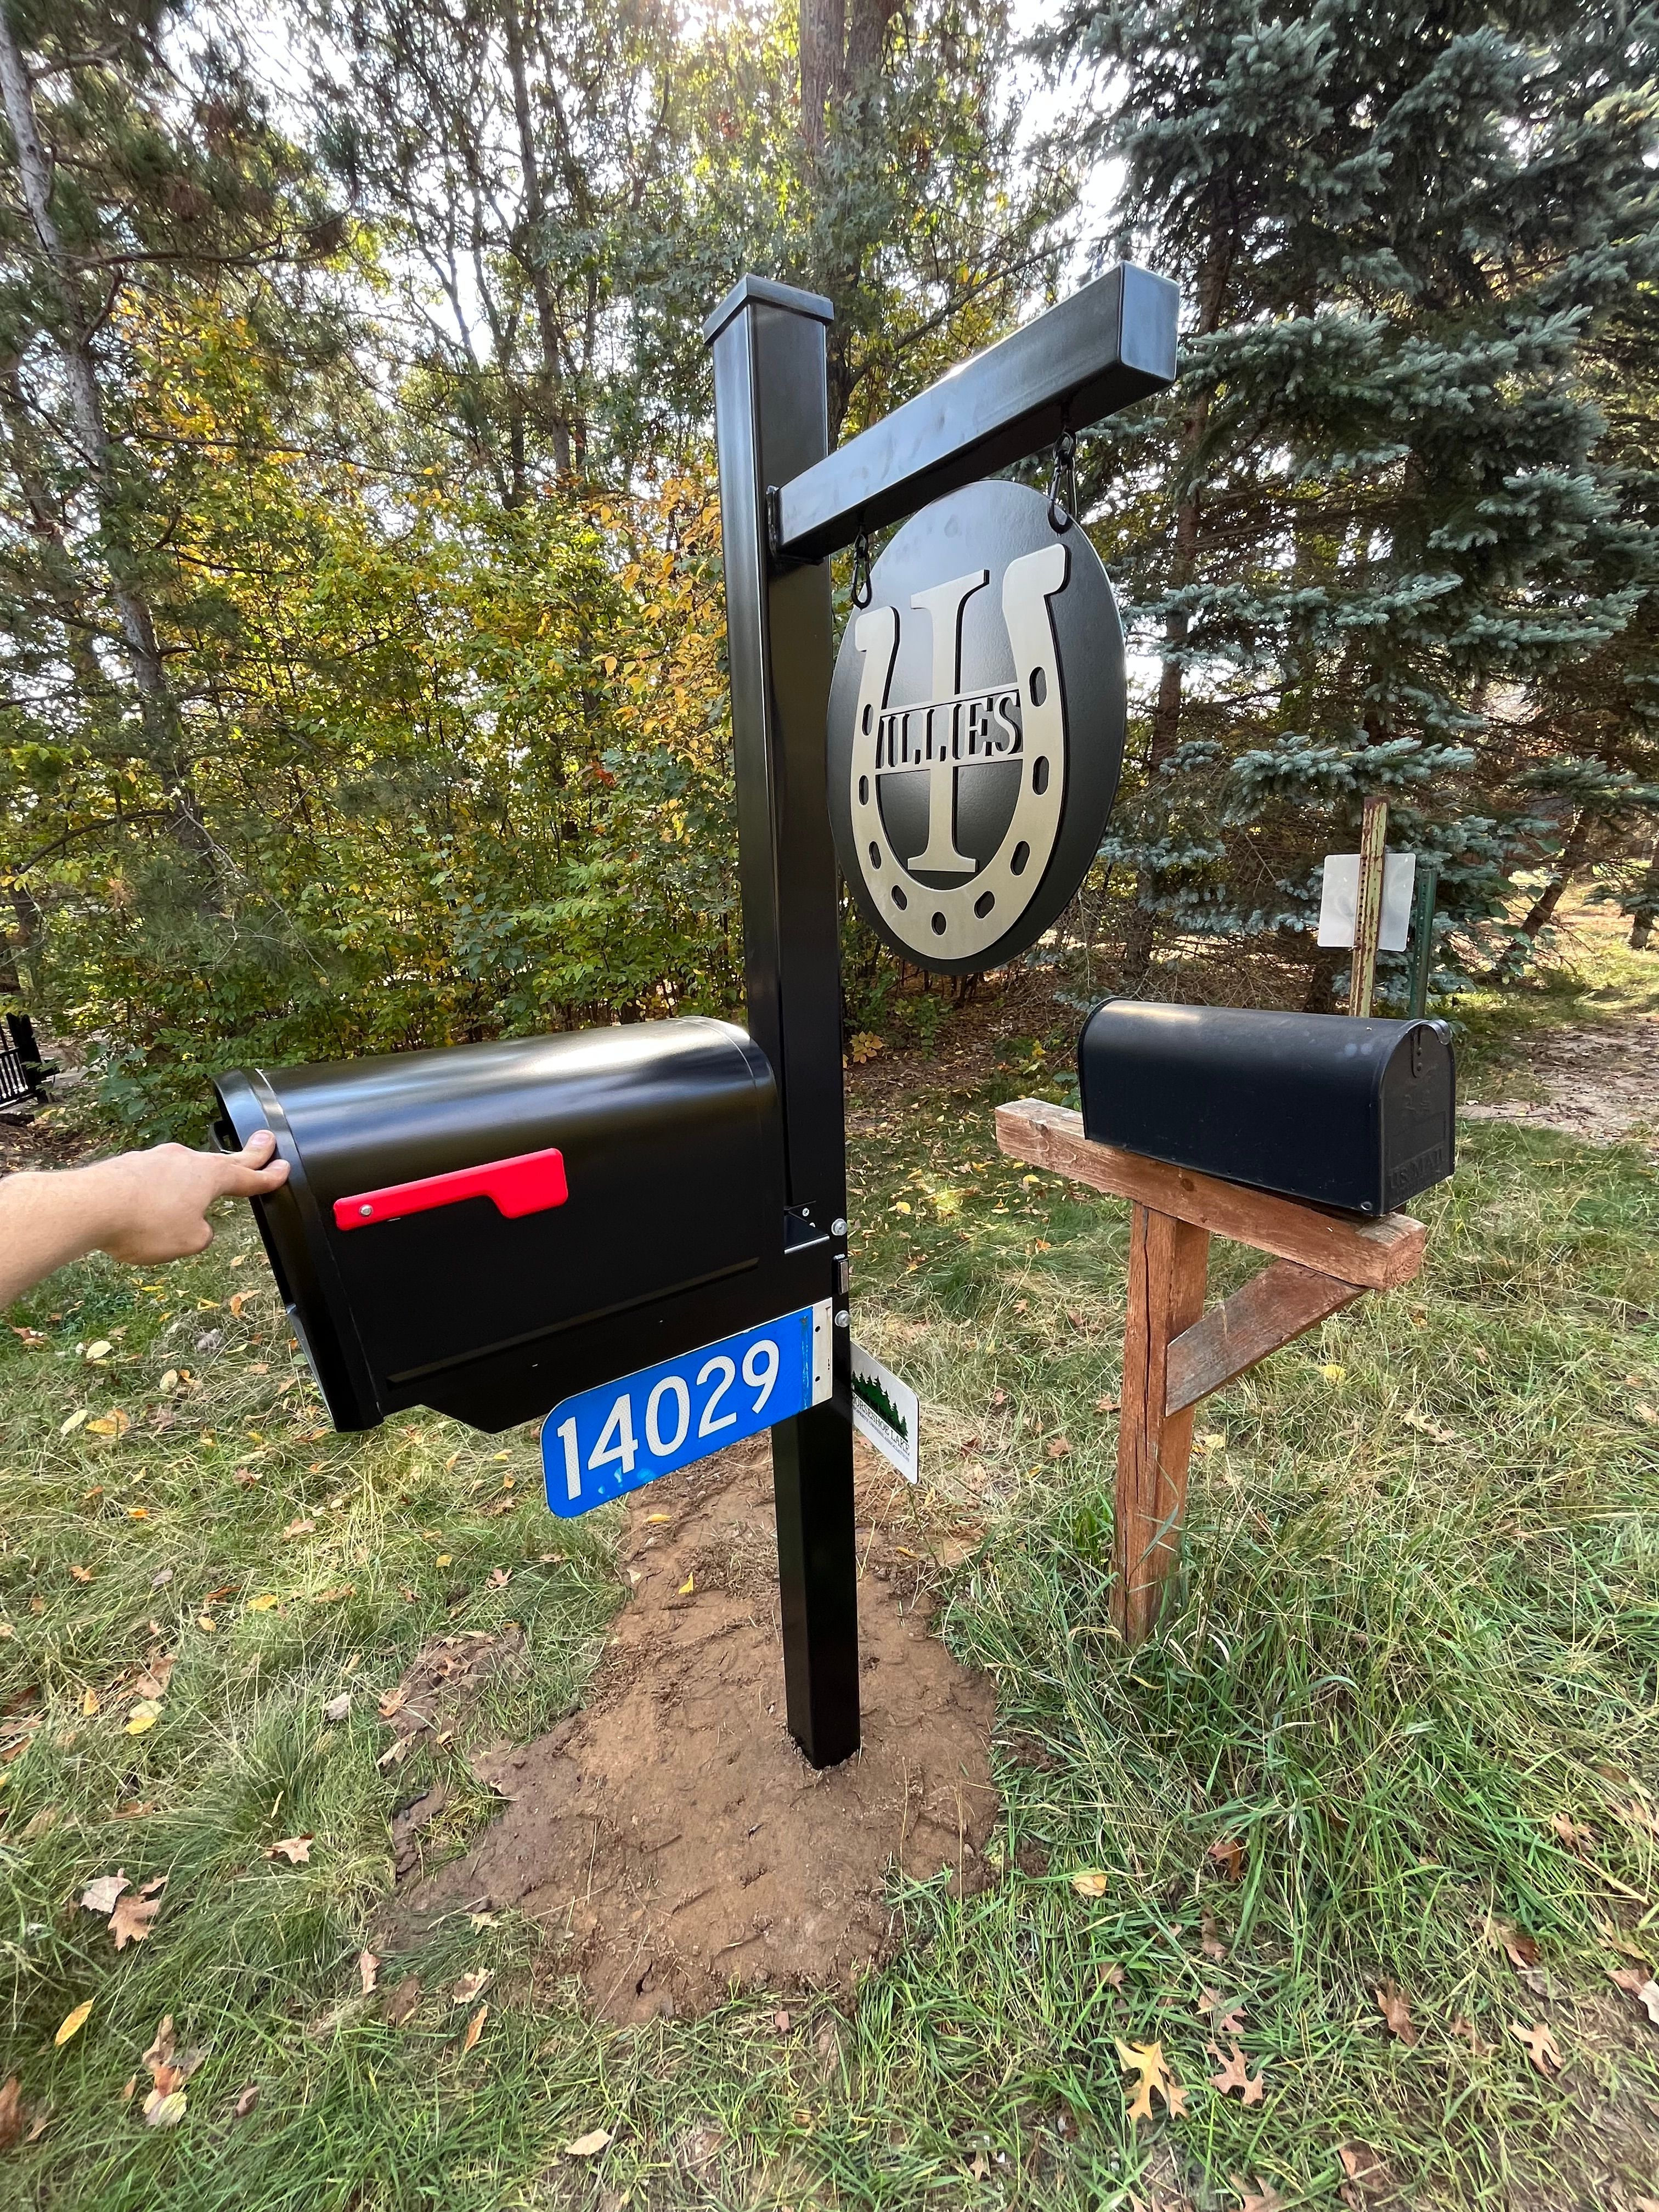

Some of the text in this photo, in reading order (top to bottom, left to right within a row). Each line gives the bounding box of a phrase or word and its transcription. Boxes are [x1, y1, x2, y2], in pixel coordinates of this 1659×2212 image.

[881, 691, 1020, 767] ILLIES
[557, 1339, 780, 1500] 14029
[853, 1393, 889, 1435] HORSESHOE
[890, 1430, 910, 1455] LAKE
